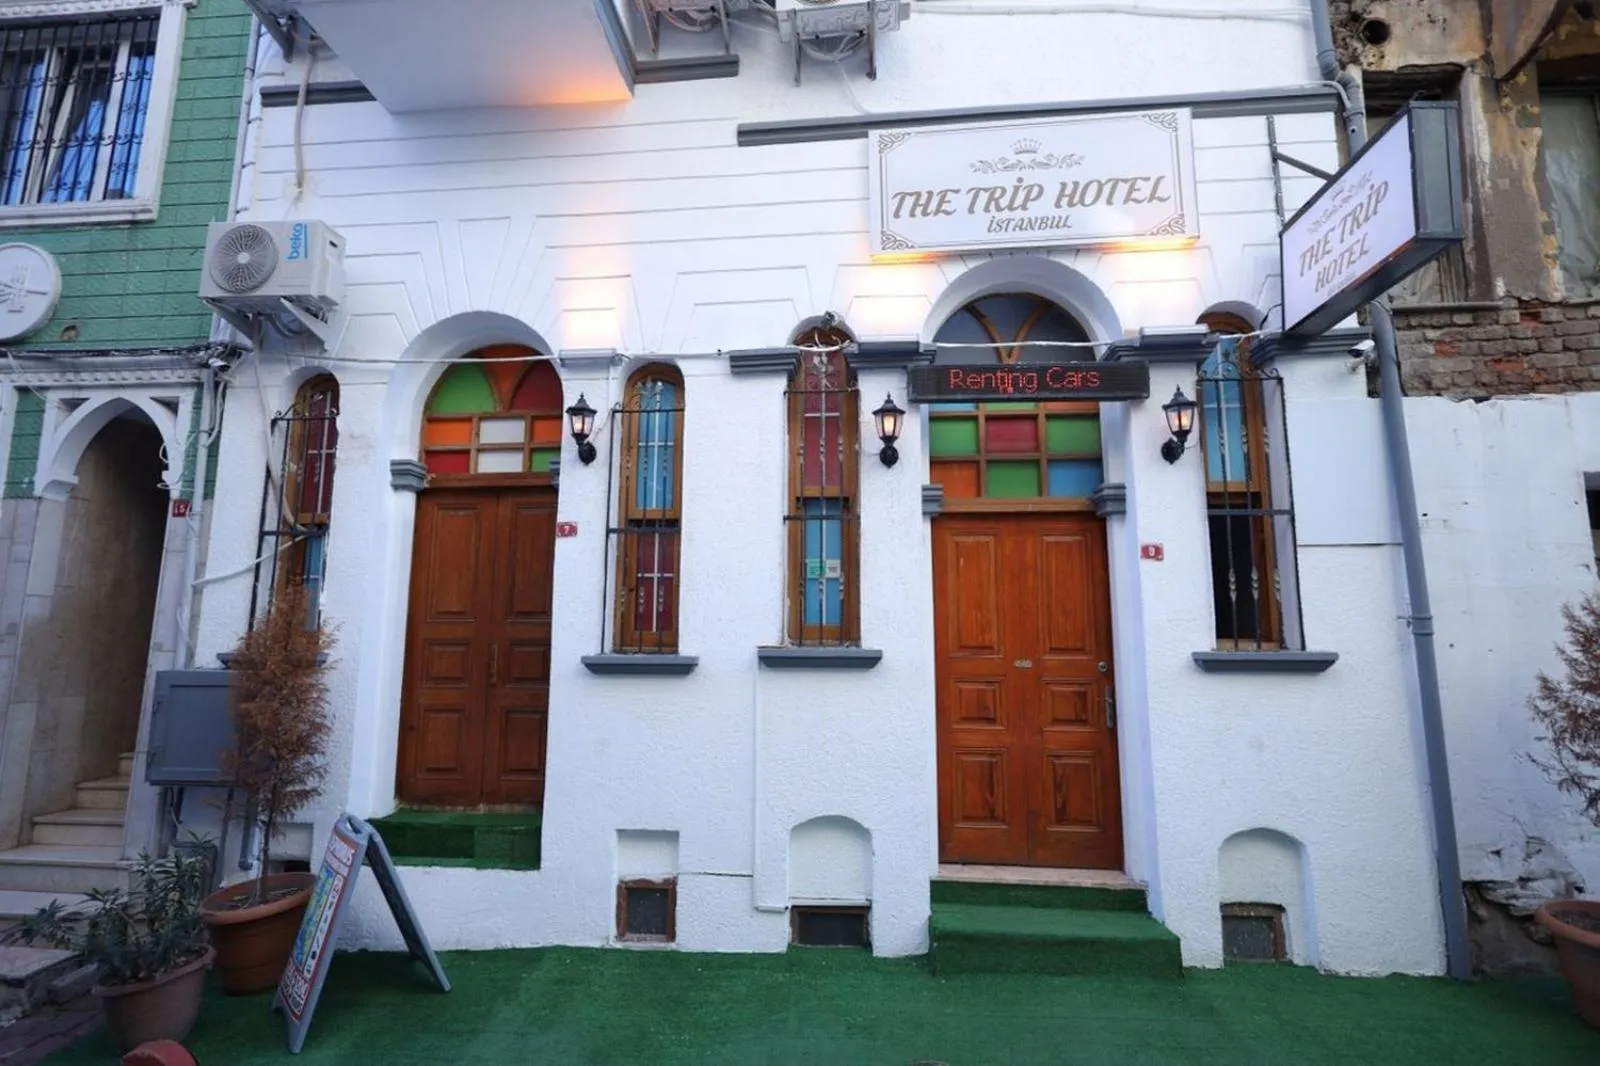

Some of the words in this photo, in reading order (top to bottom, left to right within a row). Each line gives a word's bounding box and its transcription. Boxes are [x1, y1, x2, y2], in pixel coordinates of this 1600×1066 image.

[891, 188, 961, 219] THE
[1054, 175, 1171, 210] HOTEL
[286, 222, 304, 260] beko
[1299, 225, 1337, 278] THE
[1315, 232, 1370, 293] HOTEL
[950, 368, 1038, 394] Renting
[1046, 366, 1100, 389] Cars
